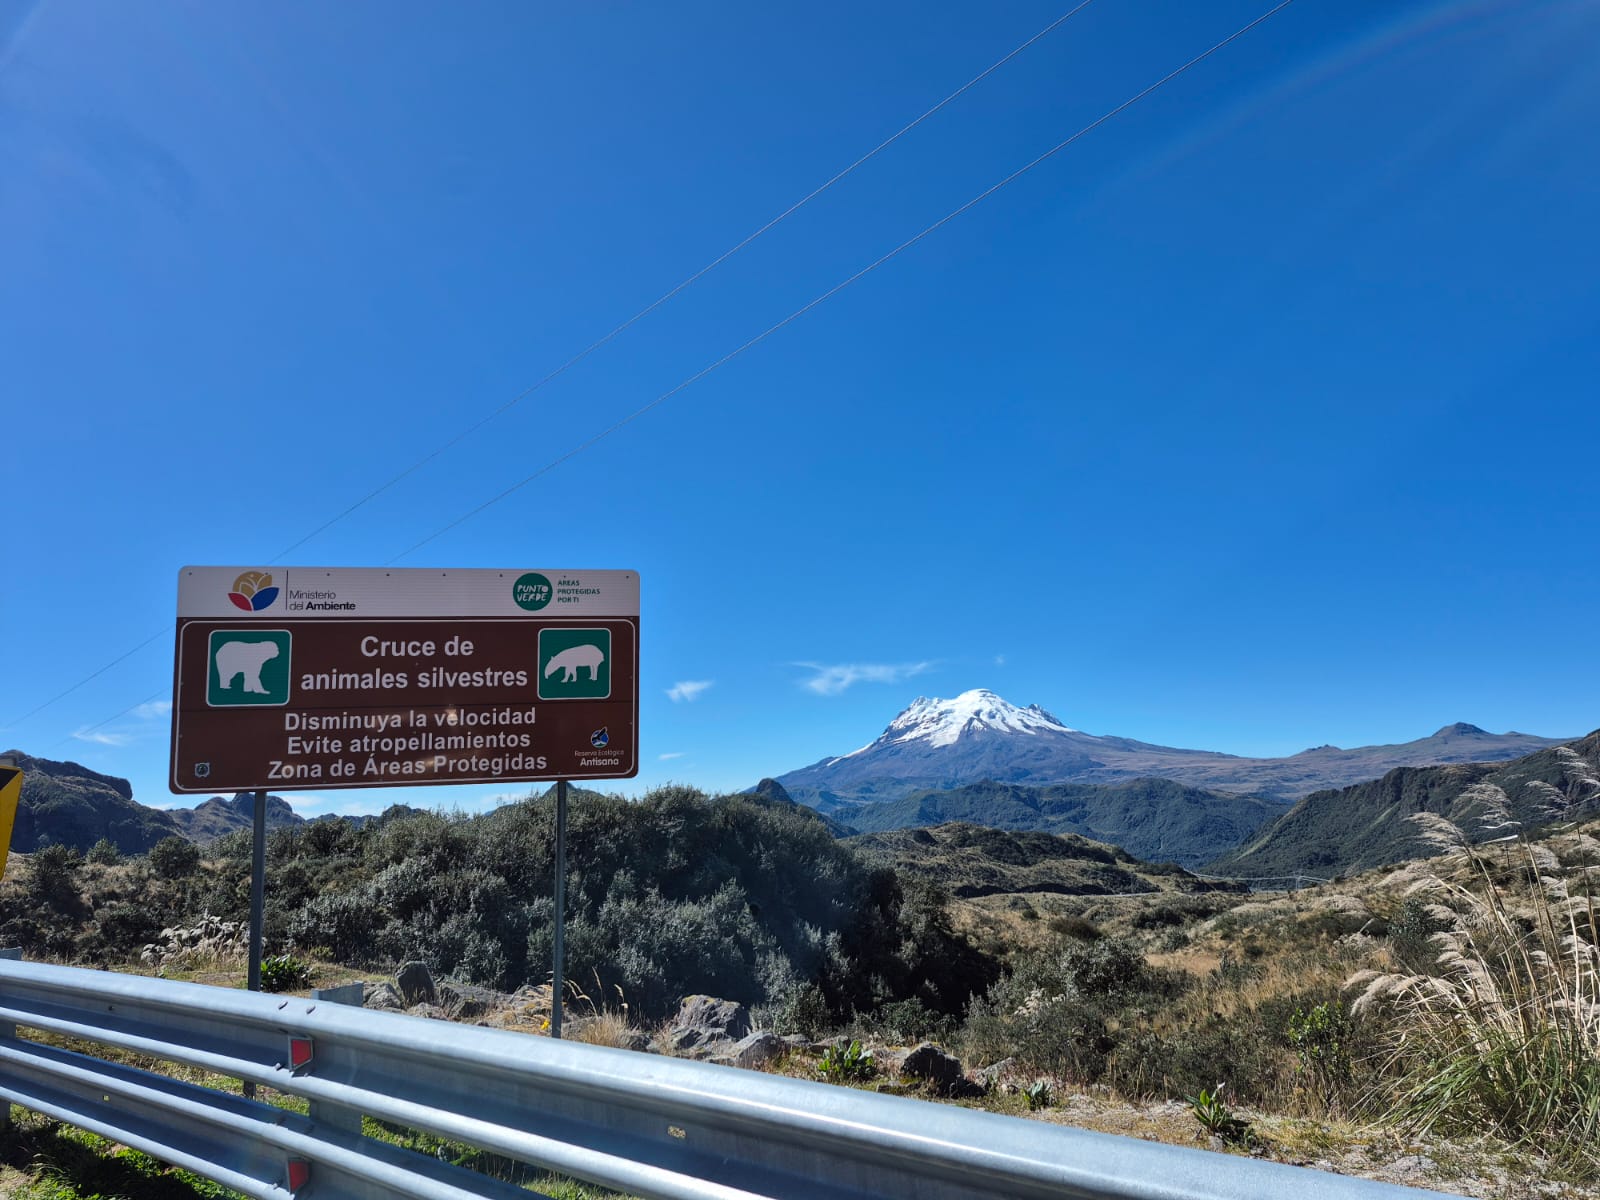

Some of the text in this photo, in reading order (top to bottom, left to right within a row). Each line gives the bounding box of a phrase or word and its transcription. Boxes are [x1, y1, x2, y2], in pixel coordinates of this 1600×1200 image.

[289, 590, 336, 600] Ministerio
[517, 584, 549, 593] PUNTO
[517, 593, 547, 602] VERDE
[289, 601, 356, 611] del Ambiente
[360, 635, 475, 657] Cruce de
[301, 667, 528, 690] animales silvestres
[285, 707, 536, 732] Disminuya la velocidad
[287, 731, 531, 755] Evite atropellamientos
[267, 753, 548, 779] Zona de Áreas Protegidas
[580, 757, 619, 767] Antisana
